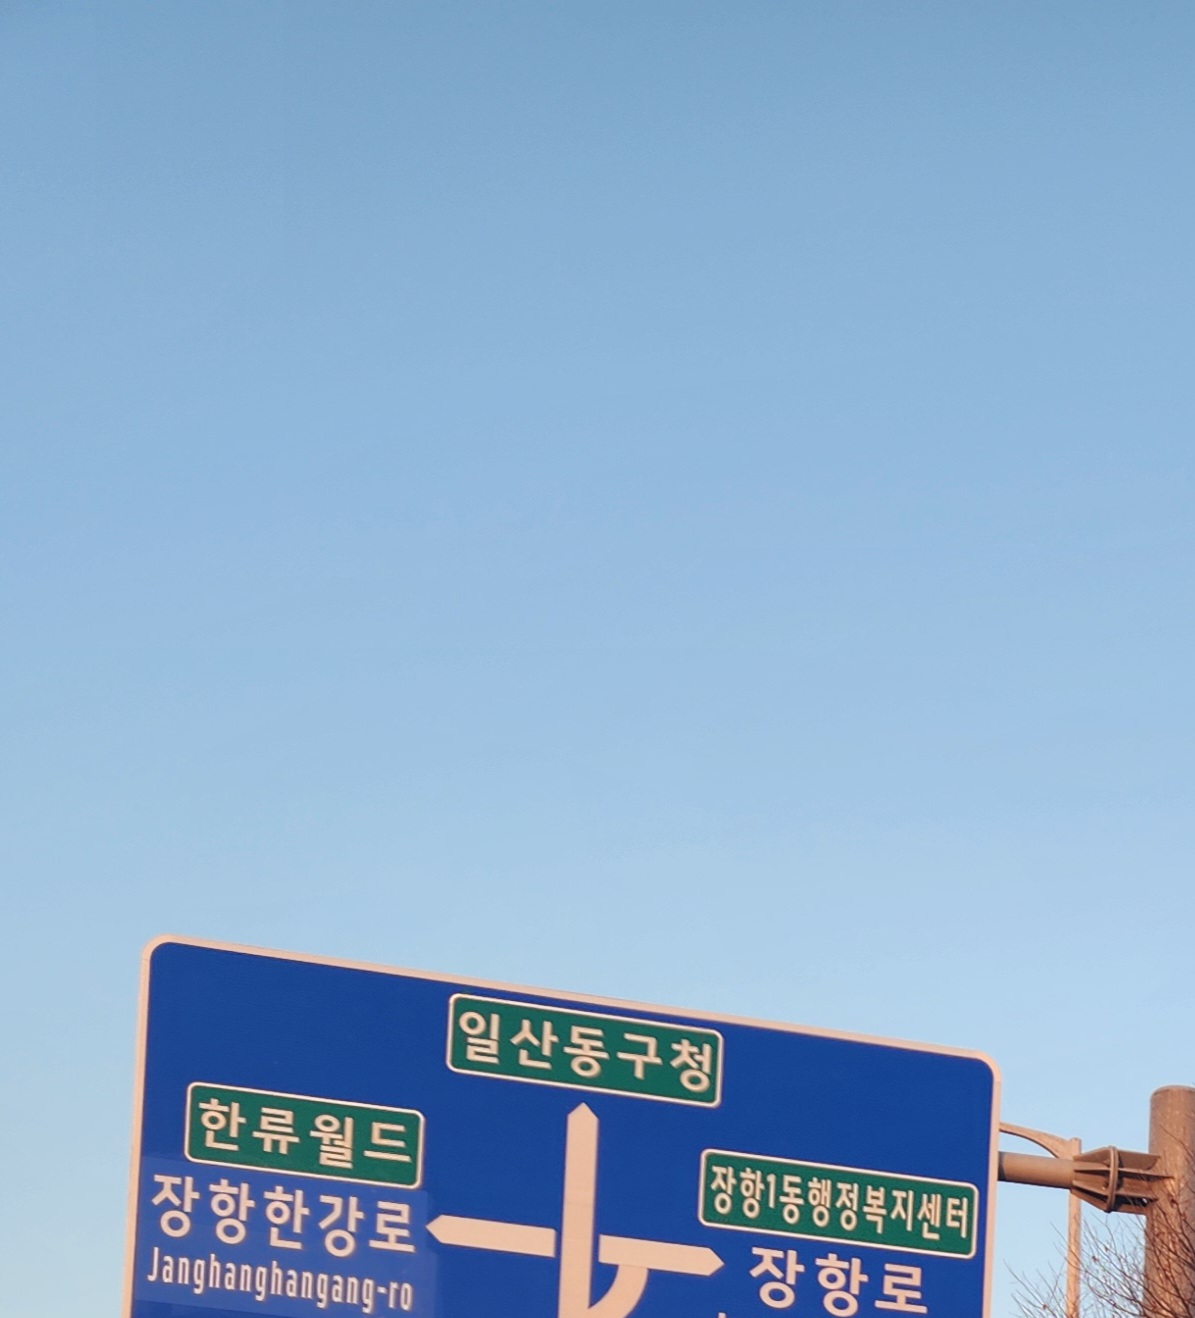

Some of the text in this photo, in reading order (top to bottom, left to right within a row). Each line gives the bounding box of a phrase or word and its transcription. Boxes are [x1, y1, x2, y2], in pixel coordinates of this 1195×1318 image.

[459, 1009, 715, 1093] 일산동구청
[198, 1097, 413, 1169] 한류월드
[151, 1174, 417, 1259] 장항한강로
[709, 1163, 970, 1242] 장항1동행정복지센터
[147, 1246, 415, 1314] Janghanghangang-ro
[748, 1245, 929, 1318] 장항로
